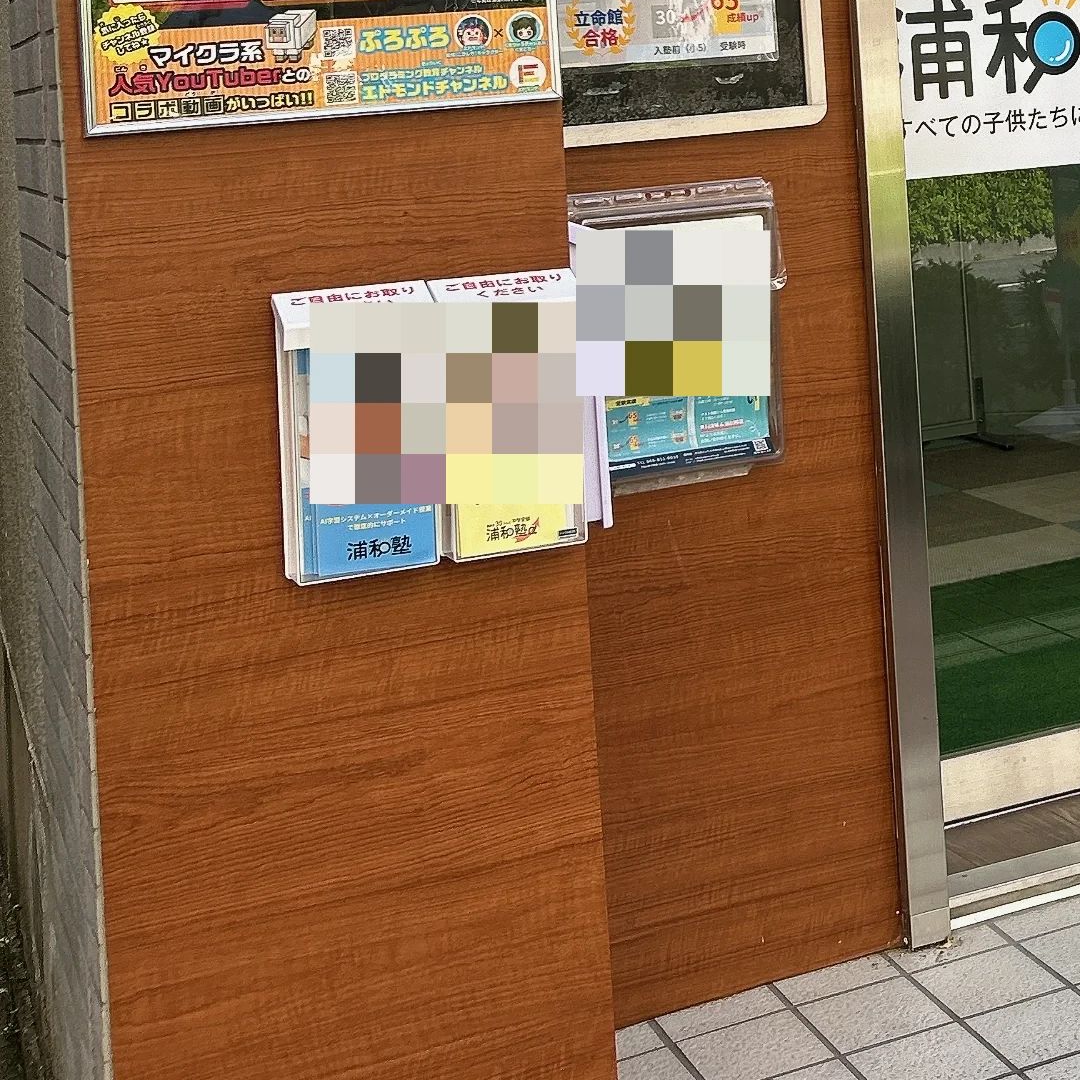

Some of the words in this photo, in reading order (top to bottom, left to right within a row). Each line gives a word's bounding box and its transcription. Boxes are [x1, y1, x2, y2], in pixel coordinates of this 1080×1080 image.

[573, 9, 623, 27] 立命館
[655, 9, 677, 25] 30
[359, 25, 451, 53] ぷろぷろ
[582, 28, 618, 48] 合格
[150, 40, 265, 67] マイクラ系
[109, 67, 310, 96] 人気YouTuberとの
[445, 273, 562, 292] ご自由にお取り
[476, 285, 544, 298] ください
[347, 535, 412, 560] 浦和塾
